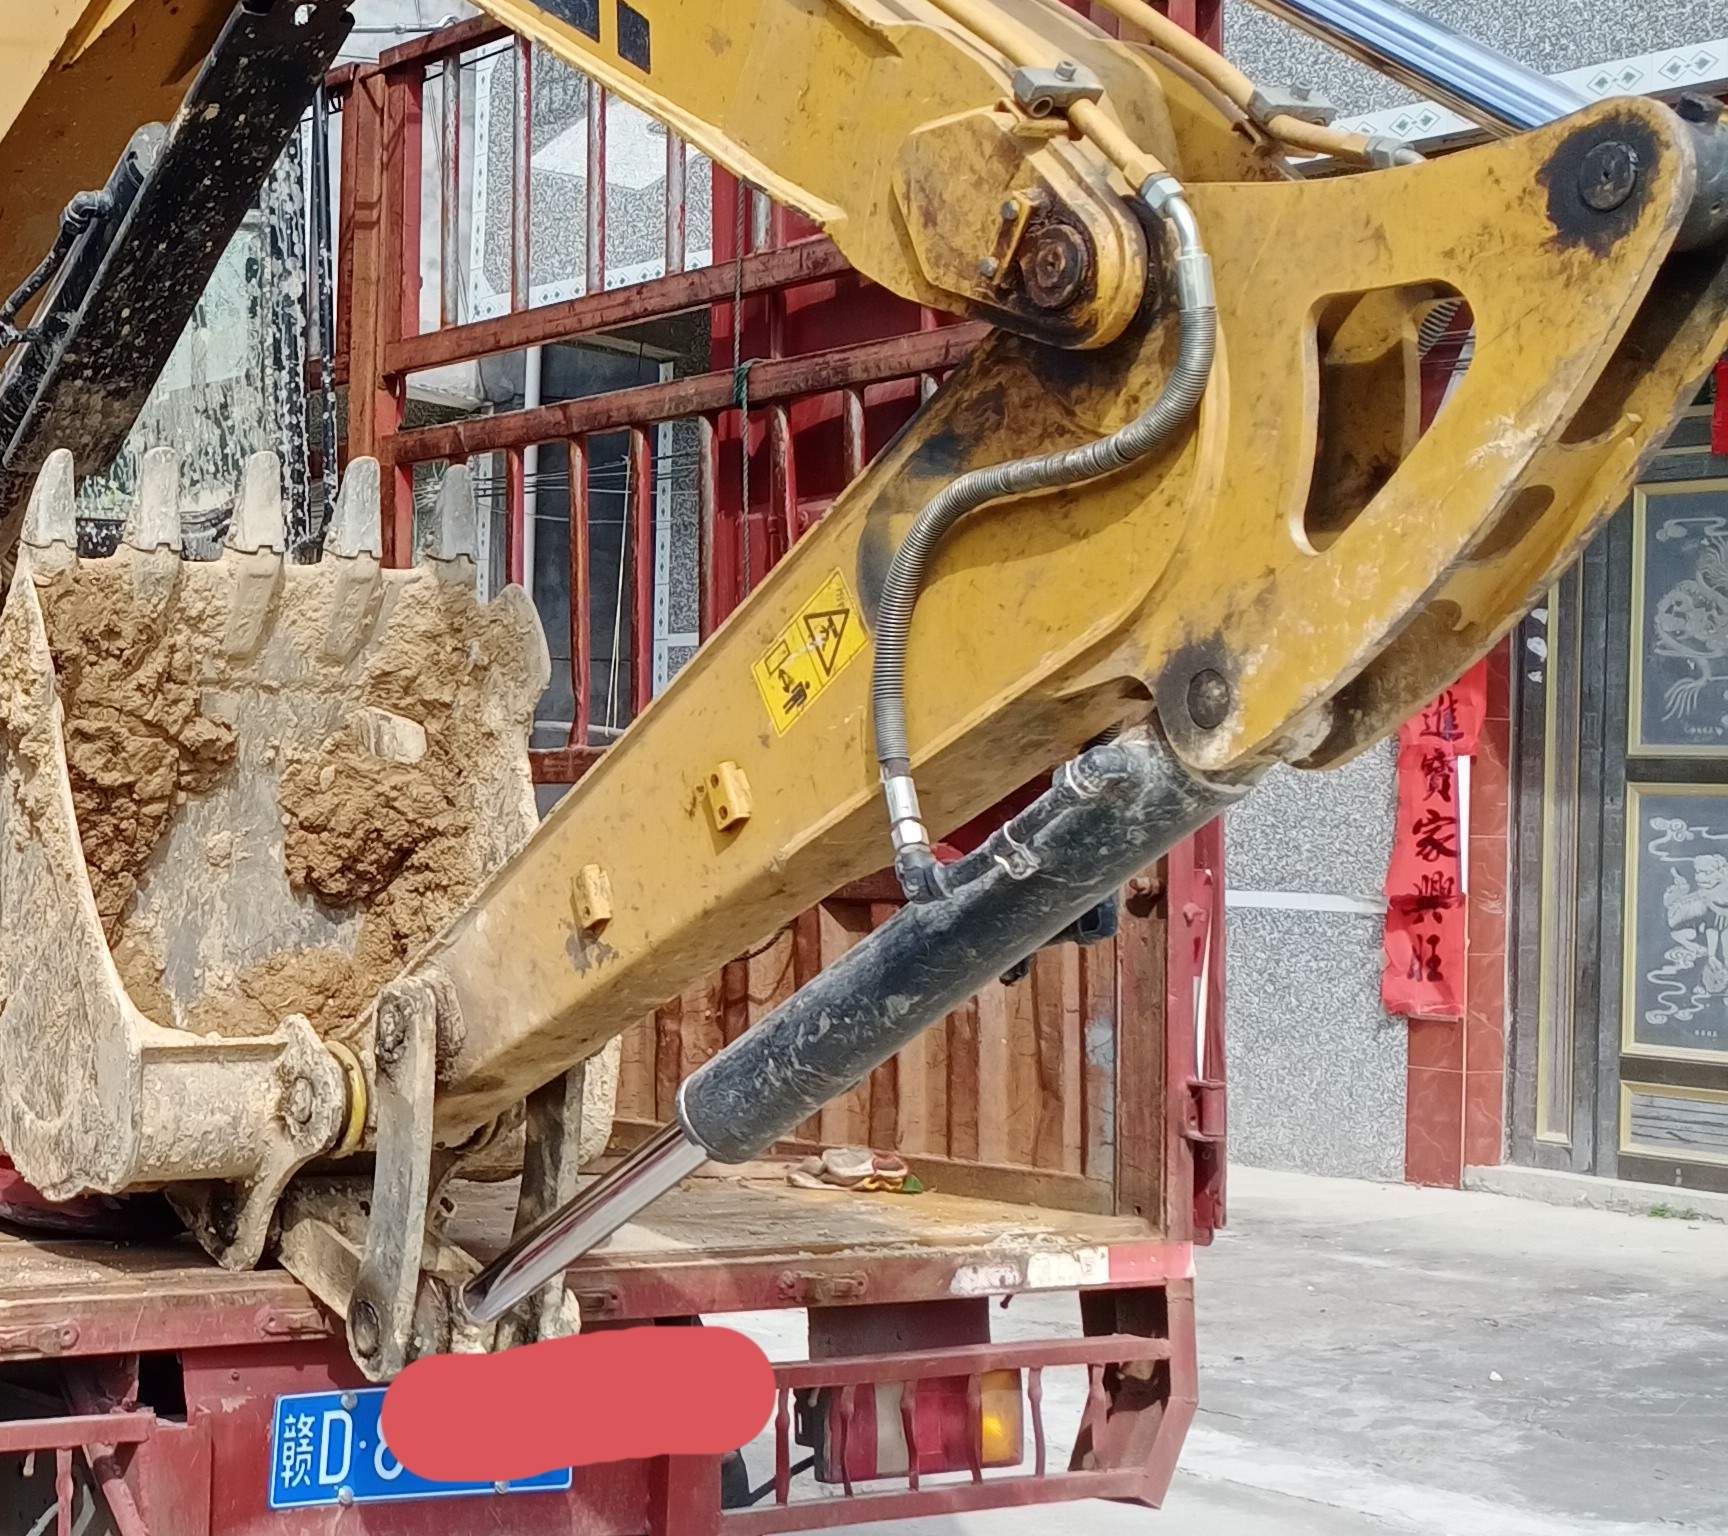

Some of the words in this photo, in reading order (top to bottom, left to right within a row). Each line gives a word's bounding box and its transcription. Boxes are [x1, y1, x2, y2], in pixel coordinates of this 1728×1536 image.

[1406, 678, 1465, 983] 進寶家興旺
